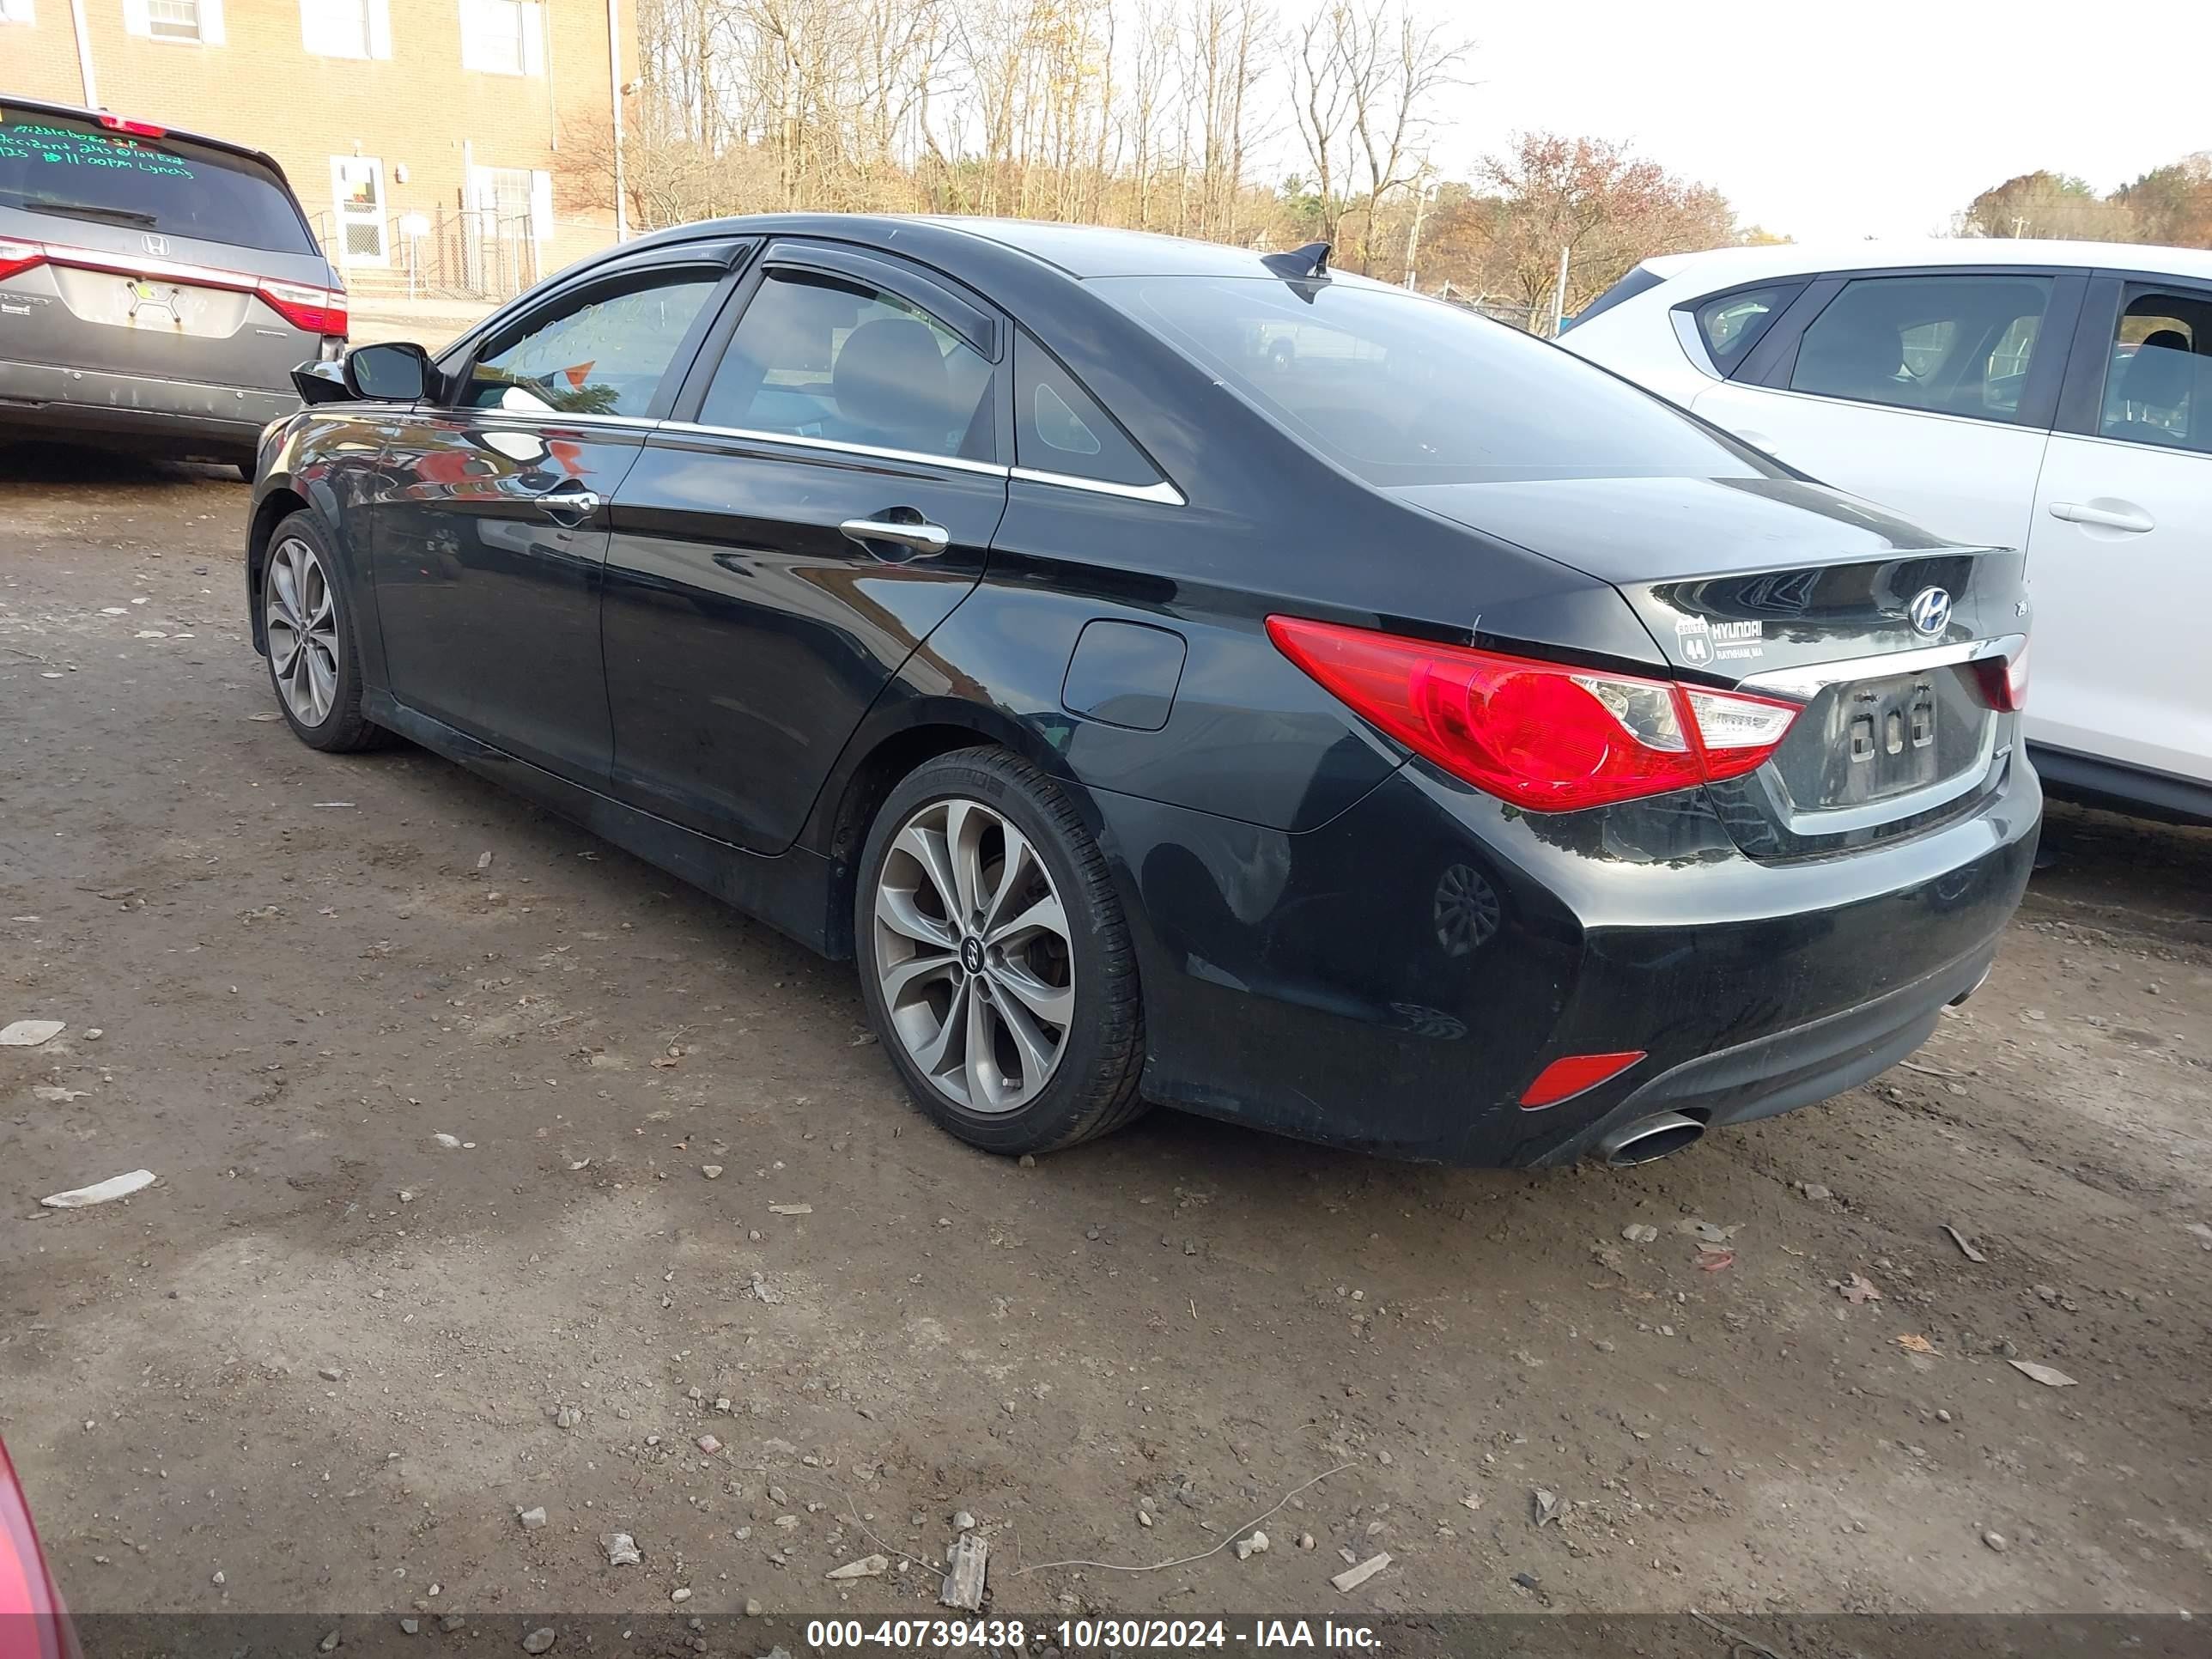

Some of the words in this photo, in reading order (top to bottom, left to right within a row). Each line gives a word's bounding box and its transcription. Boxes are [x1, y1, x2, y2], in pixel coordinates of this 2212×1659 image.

[1678, 623, 1705, 633] ROUTE
[1711, 620, 1763, 640] HYUNDAI
[1686, 639, 1707, 660] 44
